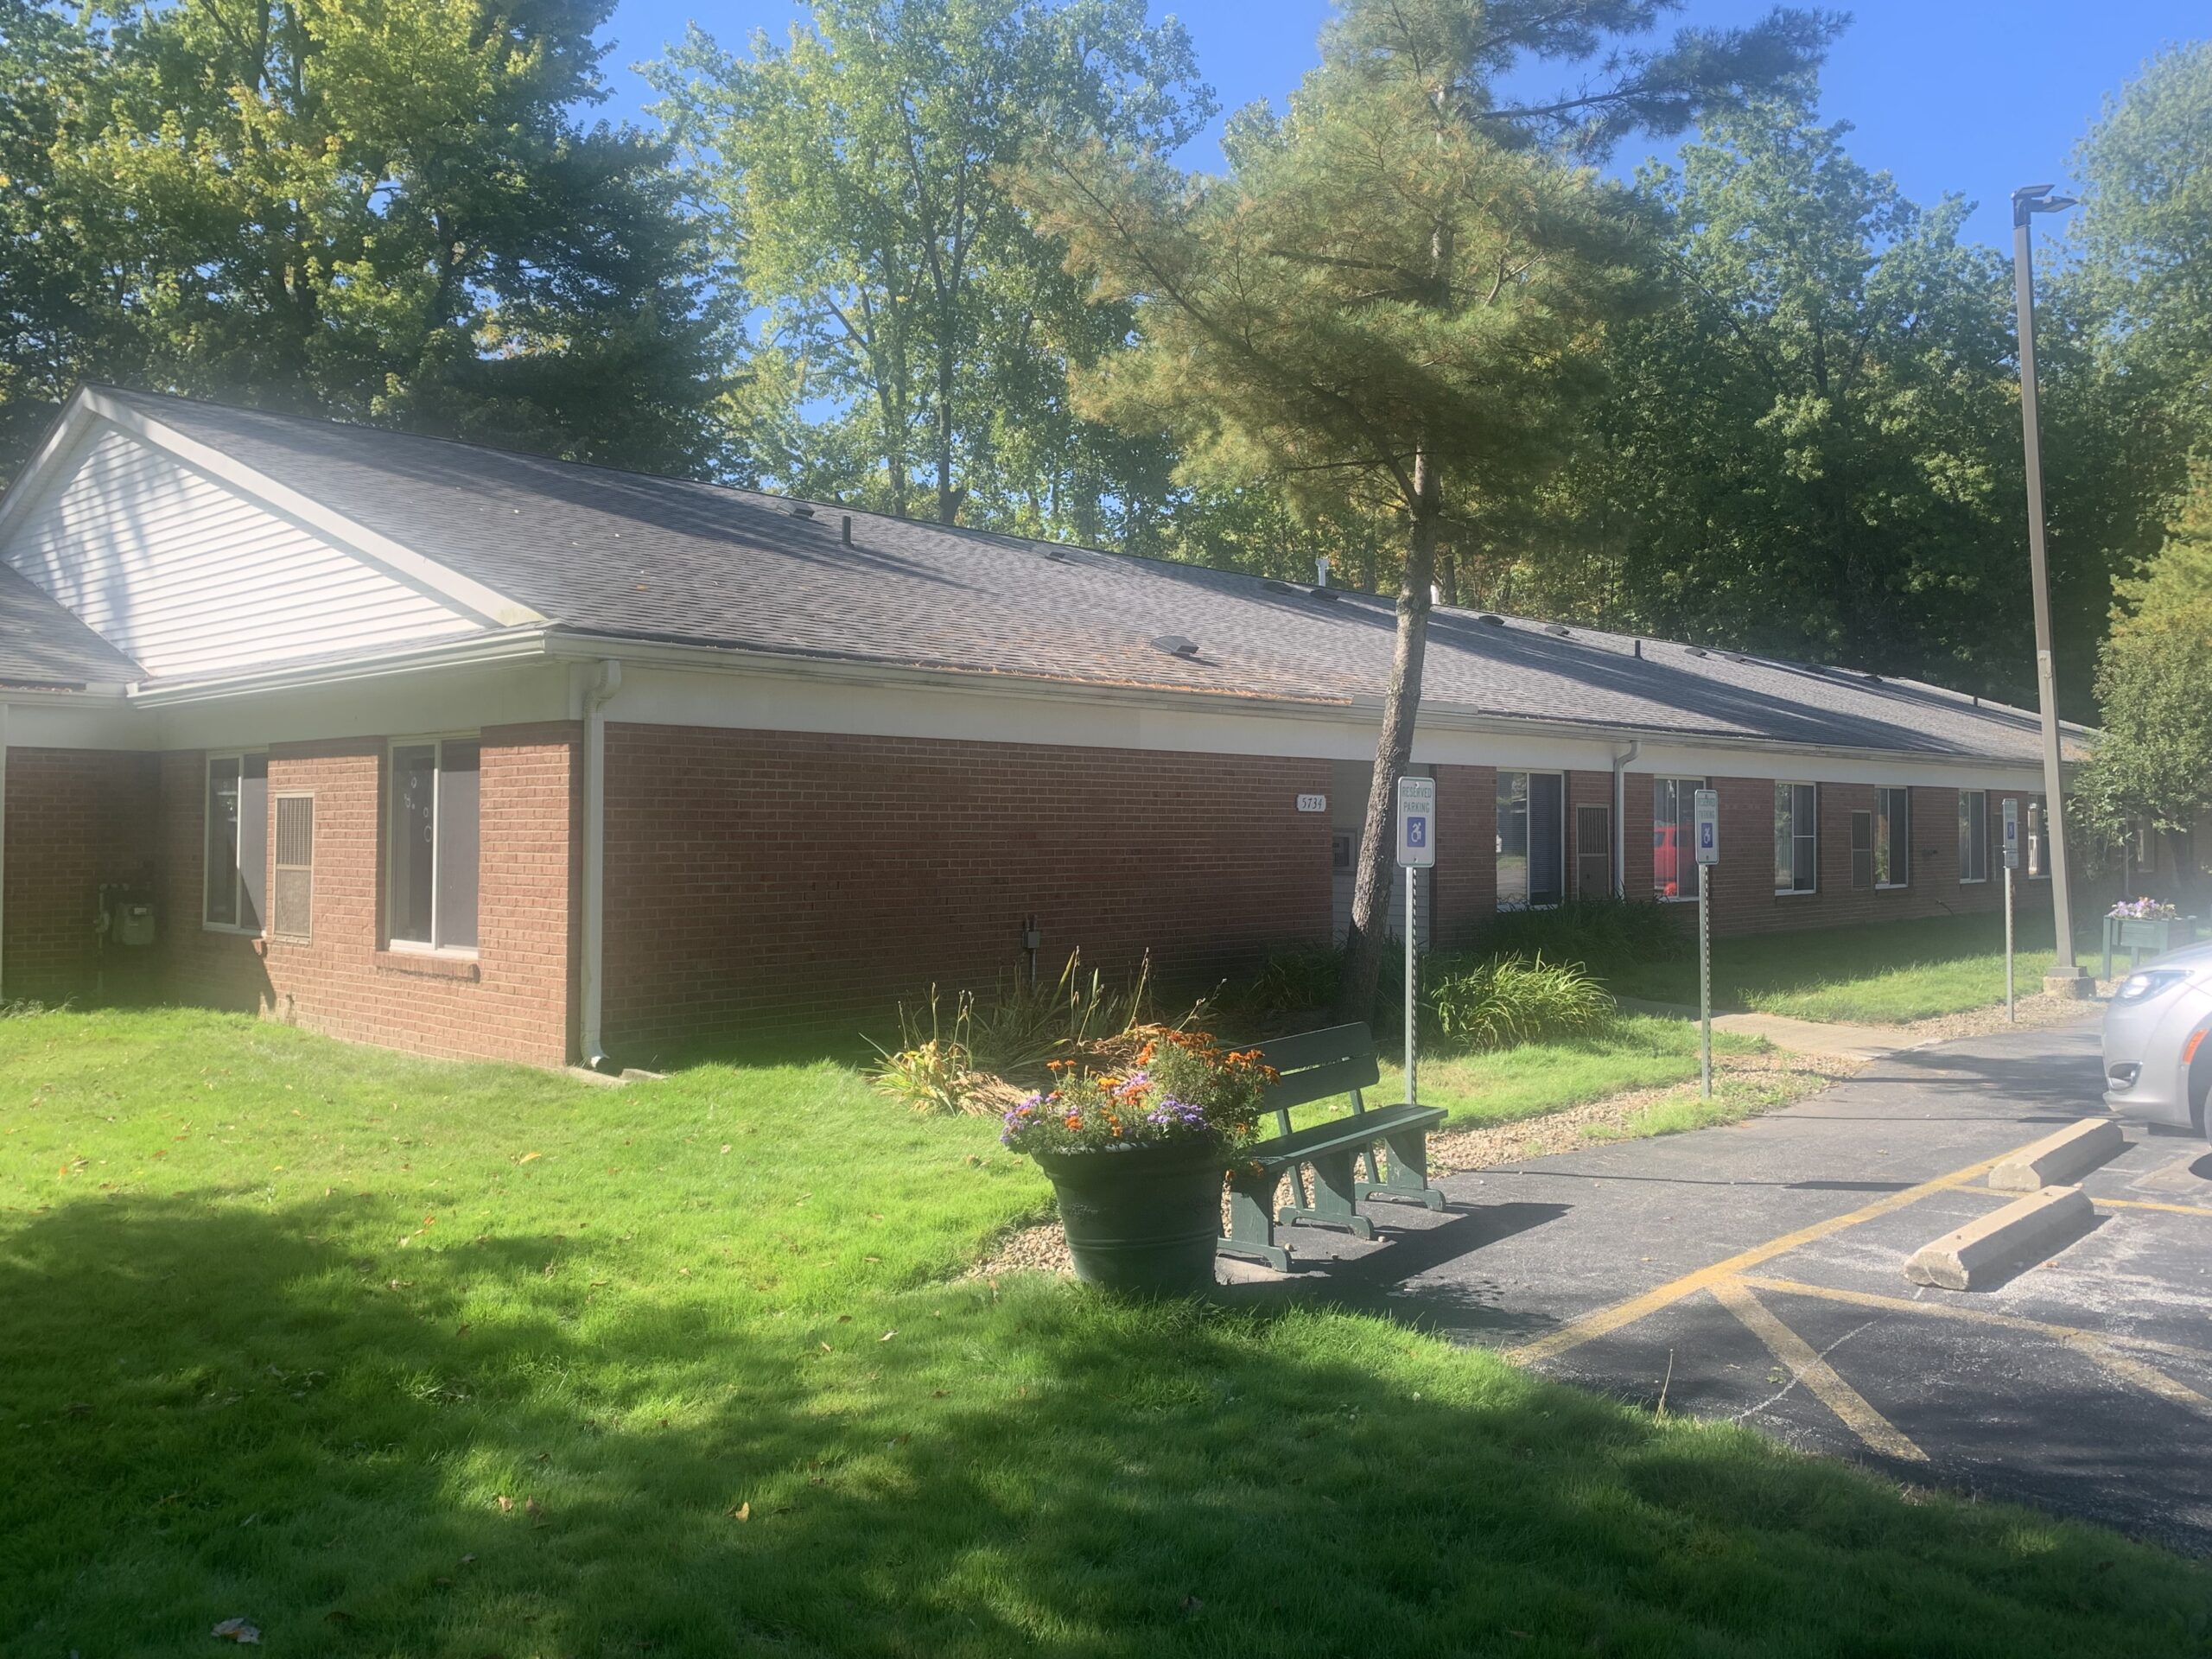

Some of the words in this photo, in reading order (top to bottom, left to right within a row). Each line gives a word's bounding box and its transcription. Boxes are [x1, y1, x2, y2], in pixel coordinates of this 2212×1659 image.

[1402, 786, 1433, 798] RESERVED
[1301, 797, 1323, 810] 5734
[1403, 801, 1431, 813] PARKING
